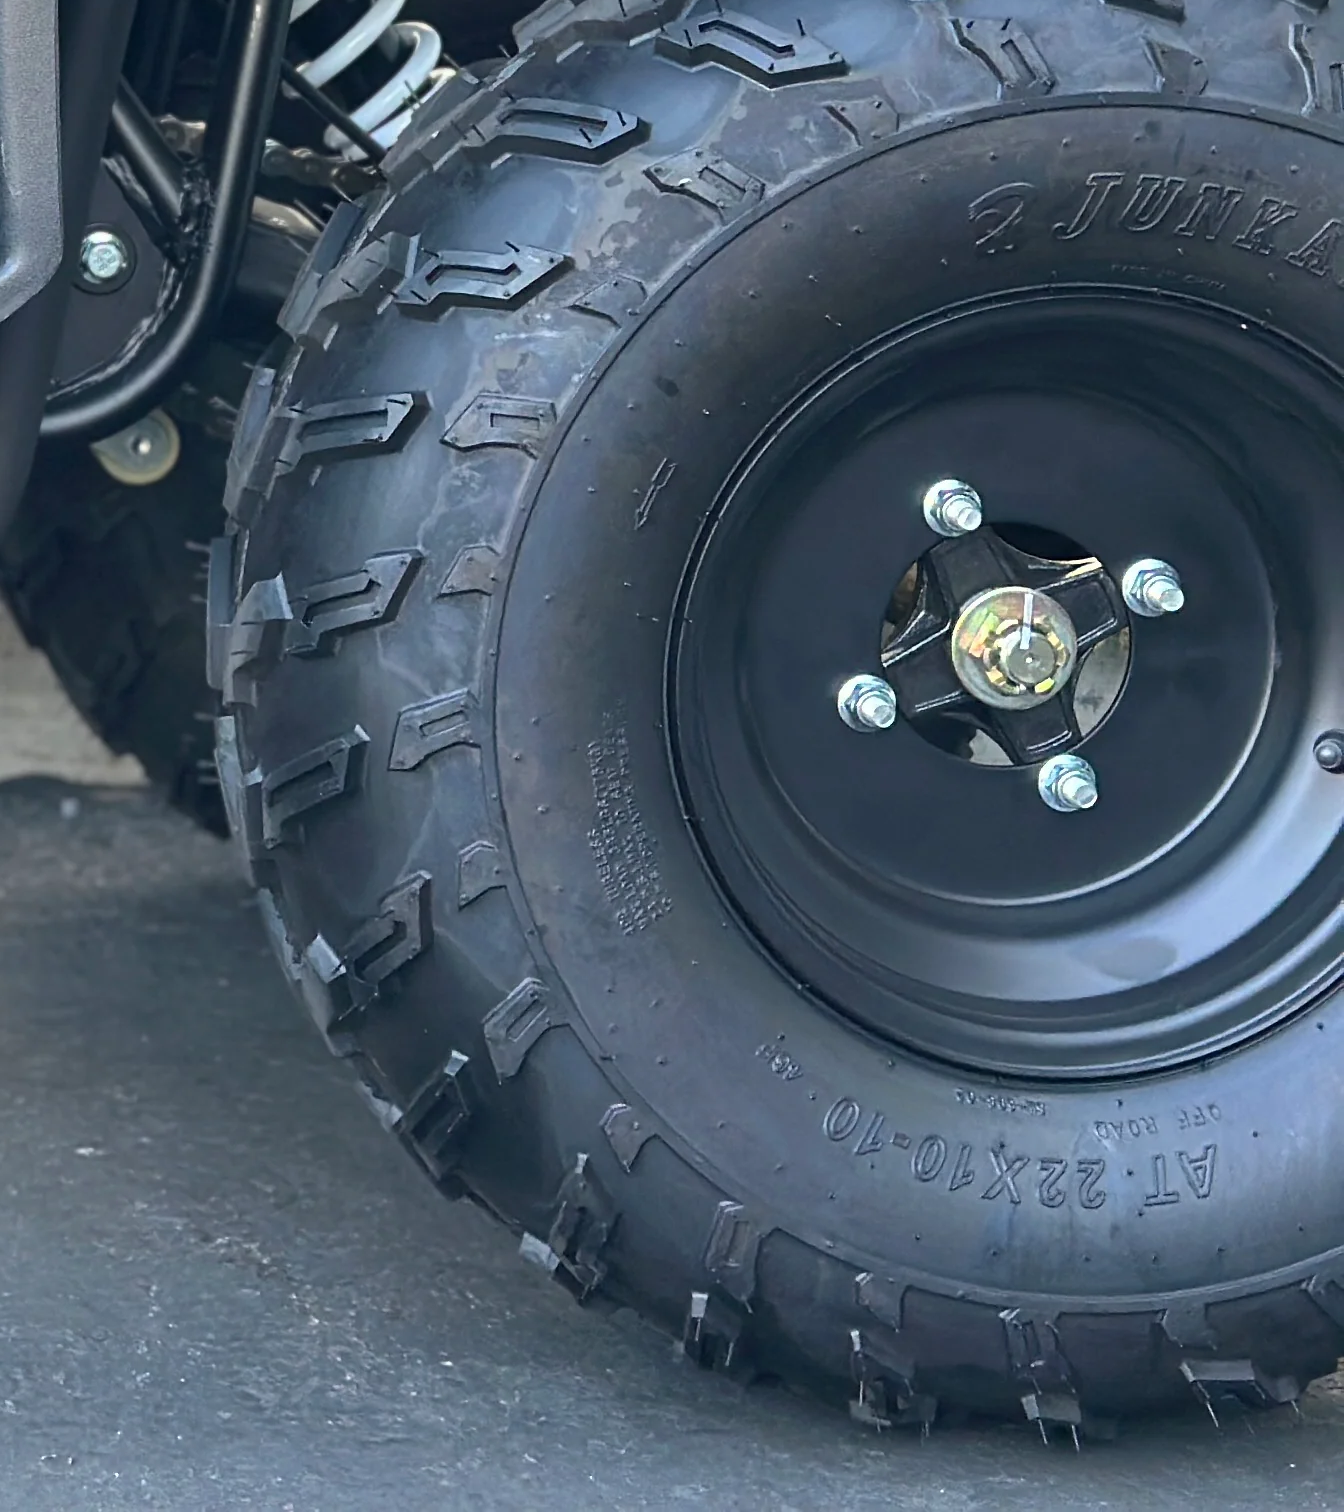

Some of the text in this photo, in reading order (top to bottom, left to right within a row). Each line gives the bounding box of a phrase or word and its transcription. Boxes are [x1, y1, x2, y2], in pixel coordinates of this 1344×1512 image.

[1051, 171, 1344, 286] JUNKA
[823, 1095, 1219, 1210] AT 22X10-10
[1092, 1103, 1223, 1144] OFF ROAD
